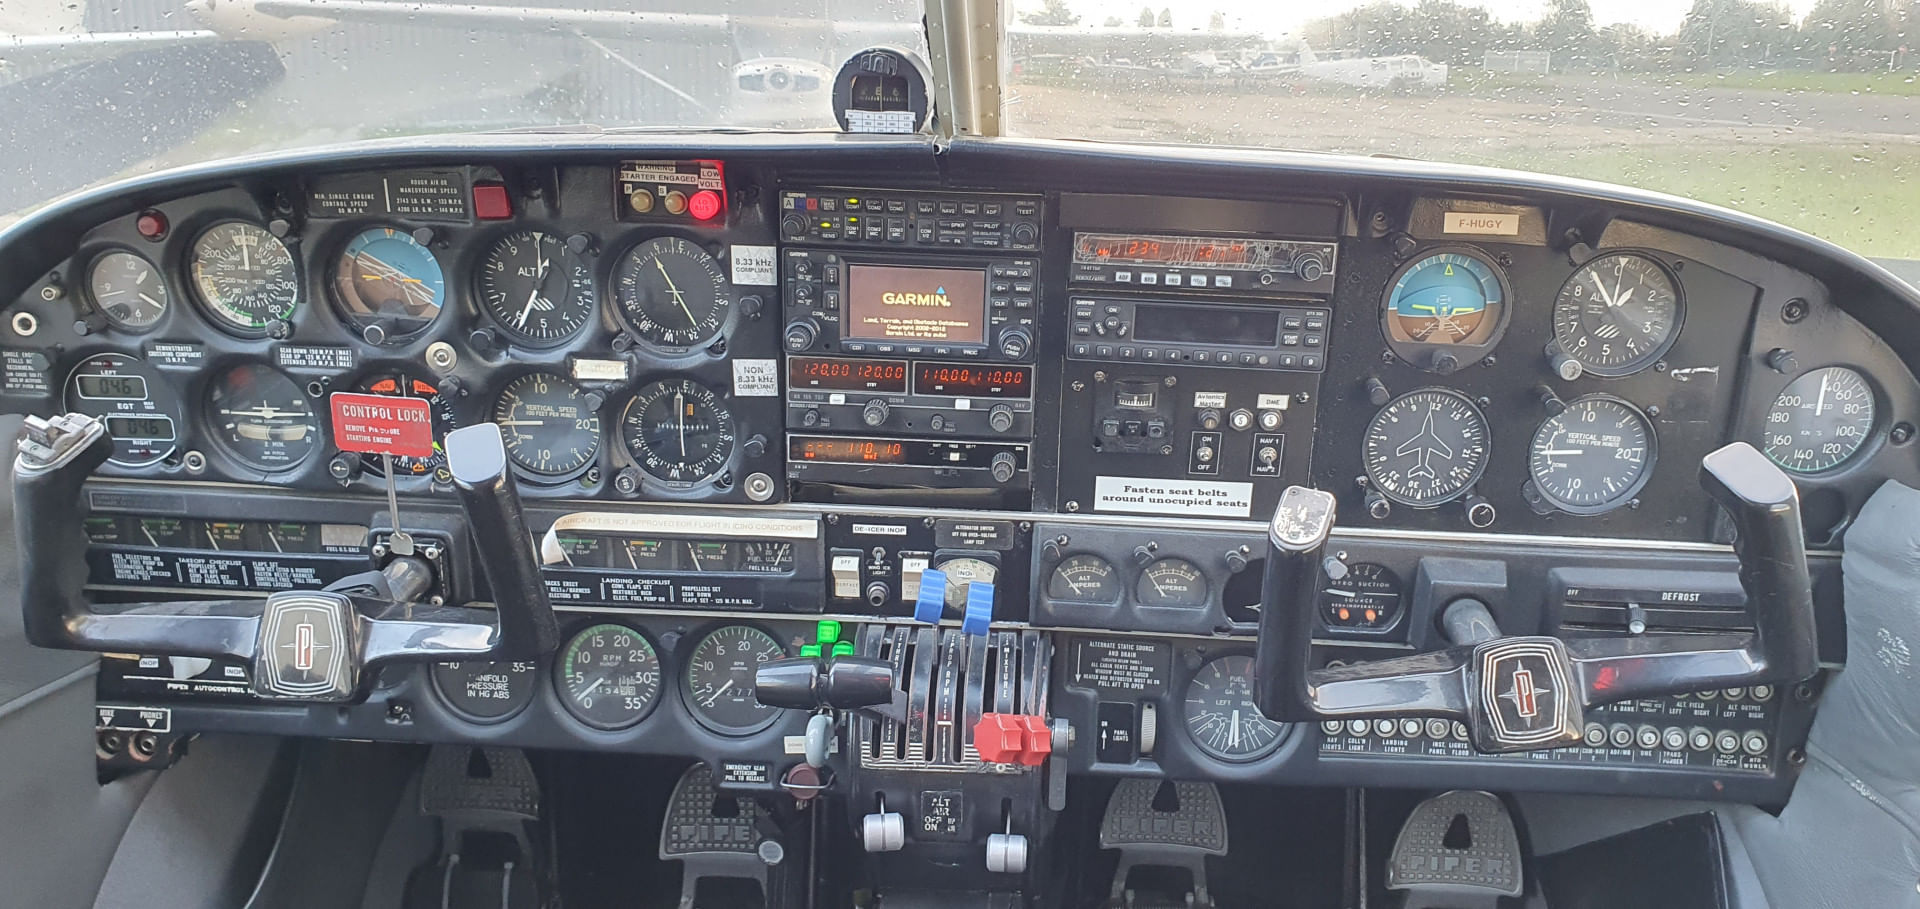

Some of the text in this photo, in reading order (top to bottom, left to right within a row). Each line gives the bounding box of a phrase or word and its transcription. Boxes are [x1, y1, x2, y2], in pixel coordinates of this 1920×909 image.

[620, 173, 696, 183] STARTER ENGAGED
[1459, 218, 1502, 229] F-HUGY
[735, 258, 772, 267] 8.33 kHz
[518, 267, 536, 276] ALT
[1574, 285, 1582, 296] 8
[1648, 290, 1656, 301] 2
[499, 292, 506, 302] 7
[882, 292, 947, 306] GARMIN
[268, 305, 281, 313] 120
[540, 318, 547, 328] 5
[1570, 322, 1577, 333] 7
[1642, 322, 1651, 333] 3
[1578, 336, 1587, 347] 6
[1626, 337, 1634, 349] 4
[1602, 344, 1610, 355] 5
[743, 366, 764, 374] NON
[804, 363, 904, 380] 120.00 120.00
[737, 375, 774, 384] 8.33 kHz
[924, 369, 1022, 384] 110.00 110.00
[100, 378, 132, 394] 046
[535, 383, 547, 394] 10
[1825, 382, 1840, 392] 40
[1778, 395, 1801, 406] 200
[1835, 390, 1851, 400] 60
[343, 405, 426, 422] CONTROL LOCK
[1843, 404, 1859, 414] 80
[1582, 411, 1595, 422] 10
[1771, 412, 1789, 422] 180
[128, 420, 159, 435] 046
[345, 424, 366, 432] REMOVE
[576, 419, 590, 430] 20
[1835, 426, 1855, 436] 100
[346, 434, 393, 444] STARTING ENGINE
[1773, 435, 1792, 445] 160
[1615, 448, 1631, 459] 20
[1794, 449, 1813, 459] 140
[1822, 444, 1841, 453] 120
[538, 449, 550, 460] 10
[1567, 478, 1581, 489] 10
[1124, 485, 1228, 497] Fasten seat belts
[1102, 495, 1248, 508] around unocupied seats
[562, 517, 600, 526] AIRCRAFT
[635, 520, 673, 528] APPROVED
[754, 523, 802, 532] CONDITIONS
[854, 526, 885, 534] DE-ICER
[1662, 592, 1700, 601] DEFROST
[592, 635, 605, 648] 15
[613, 635, 631, 648] 20
[737, 640, 751, 651] 20
[1089, 641, 1115, 649] ALTERNATE
[629, 649, 646, 662] 25
[716, 645, 725, 656] 15
[577, 651, 591, 664] 10
[756, 652, 769, 662] 25
[140, 659, 158, 667] INOP
[512, 662, 526, 672] 35
[704, 661, 714, 671] 10
[226, 668, 242, 676] INOP
[575, 671, 584, 684] 5
[635, 671, 652, 684] 30
[167, 683, 245, 694] PIPER AUTOCONTROL
[466, 682, 509, 691] PRESSURE
[705, 683, 713, 693] 5
[479, 690, 490, 698] HG
[493, 691, 510, 699] ABS
[583, 697, 593, 709] 0
[624, 697, 642, 710] 35
[140, 711, 163, 720] PHONES
[931, 798, 951, 807] ALT
[932, 807, 949, 816] AIR
[924, 816, 942, 824] OFF
[1119, 815, 1210, 836] PIPER
[924, 823, 938, 831] ON
[1410, 854, 1502, 875] PIPER
